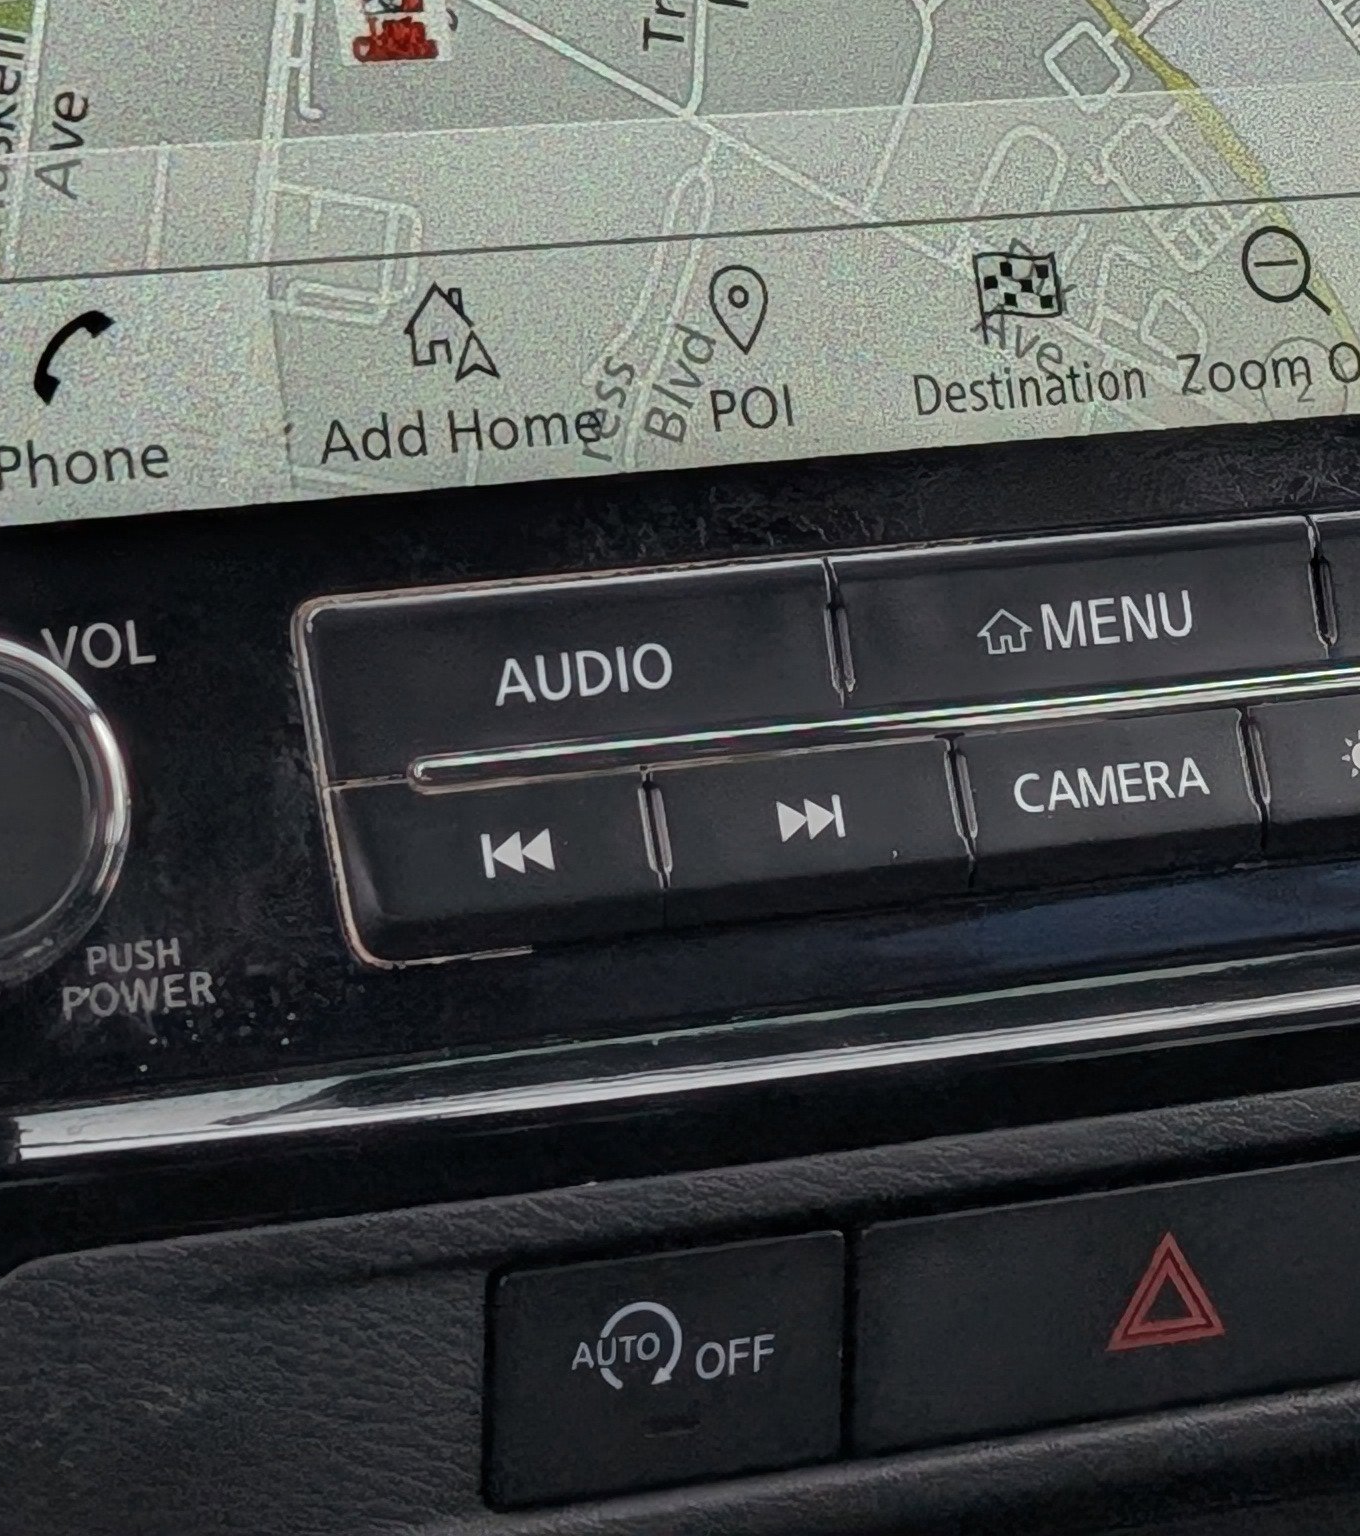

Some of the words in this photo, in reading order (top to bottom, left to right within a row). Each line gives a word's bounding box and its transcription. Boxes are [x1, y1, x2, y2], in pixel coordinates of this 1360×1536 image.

[34, 90, 90, 200] Ave
[643, 323, 717, 443] Blvd
[913, 360, 1146, 416] Destination
[1176, 352, 1313, 395] Zoom
[321, 412, 429, 465] Add
[446, 402, 602, 456] Home
[710, 383, 794, 432] POI
[42, 620, 157, 669] VOL
[1042, 589, 1194, 652] MENU
[495, 642, 673, 706] AUDIO
[1013, 756, 1210, 813] CAMERA
[86, 938, 181, 972] PUSH
[61, 970, 215, 1017] POWER
[571, 1332, 661, 1371] AUTO
[695, 1334, 776, 1380] OFF
